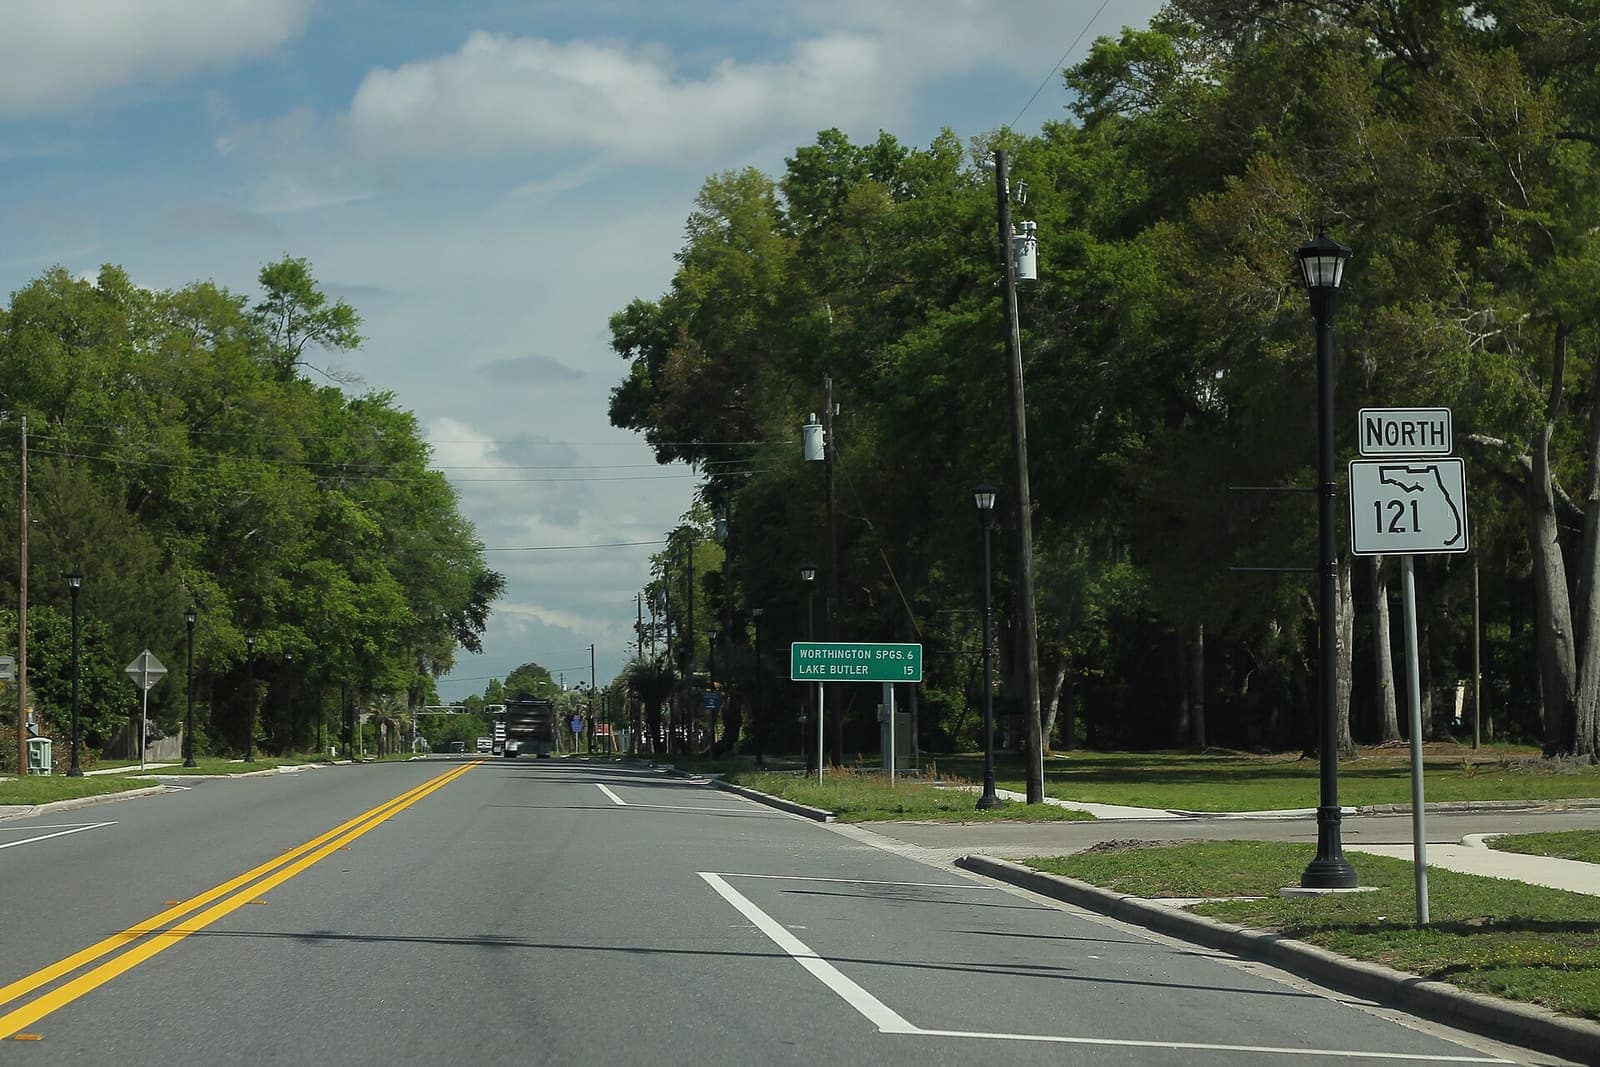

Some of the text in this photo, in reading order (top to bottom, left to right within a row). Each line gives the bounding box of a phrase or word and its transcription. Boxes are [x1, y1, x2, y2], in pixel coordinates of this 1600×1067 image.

[1366, 417, 1445, 446] NORTH
[1373, 499, 1423, 533] 121
[800, 649, 914, 660] WORTHINGTON SPGS. 6
[799, 664, 914, 675] LAKE BUTLER 15
